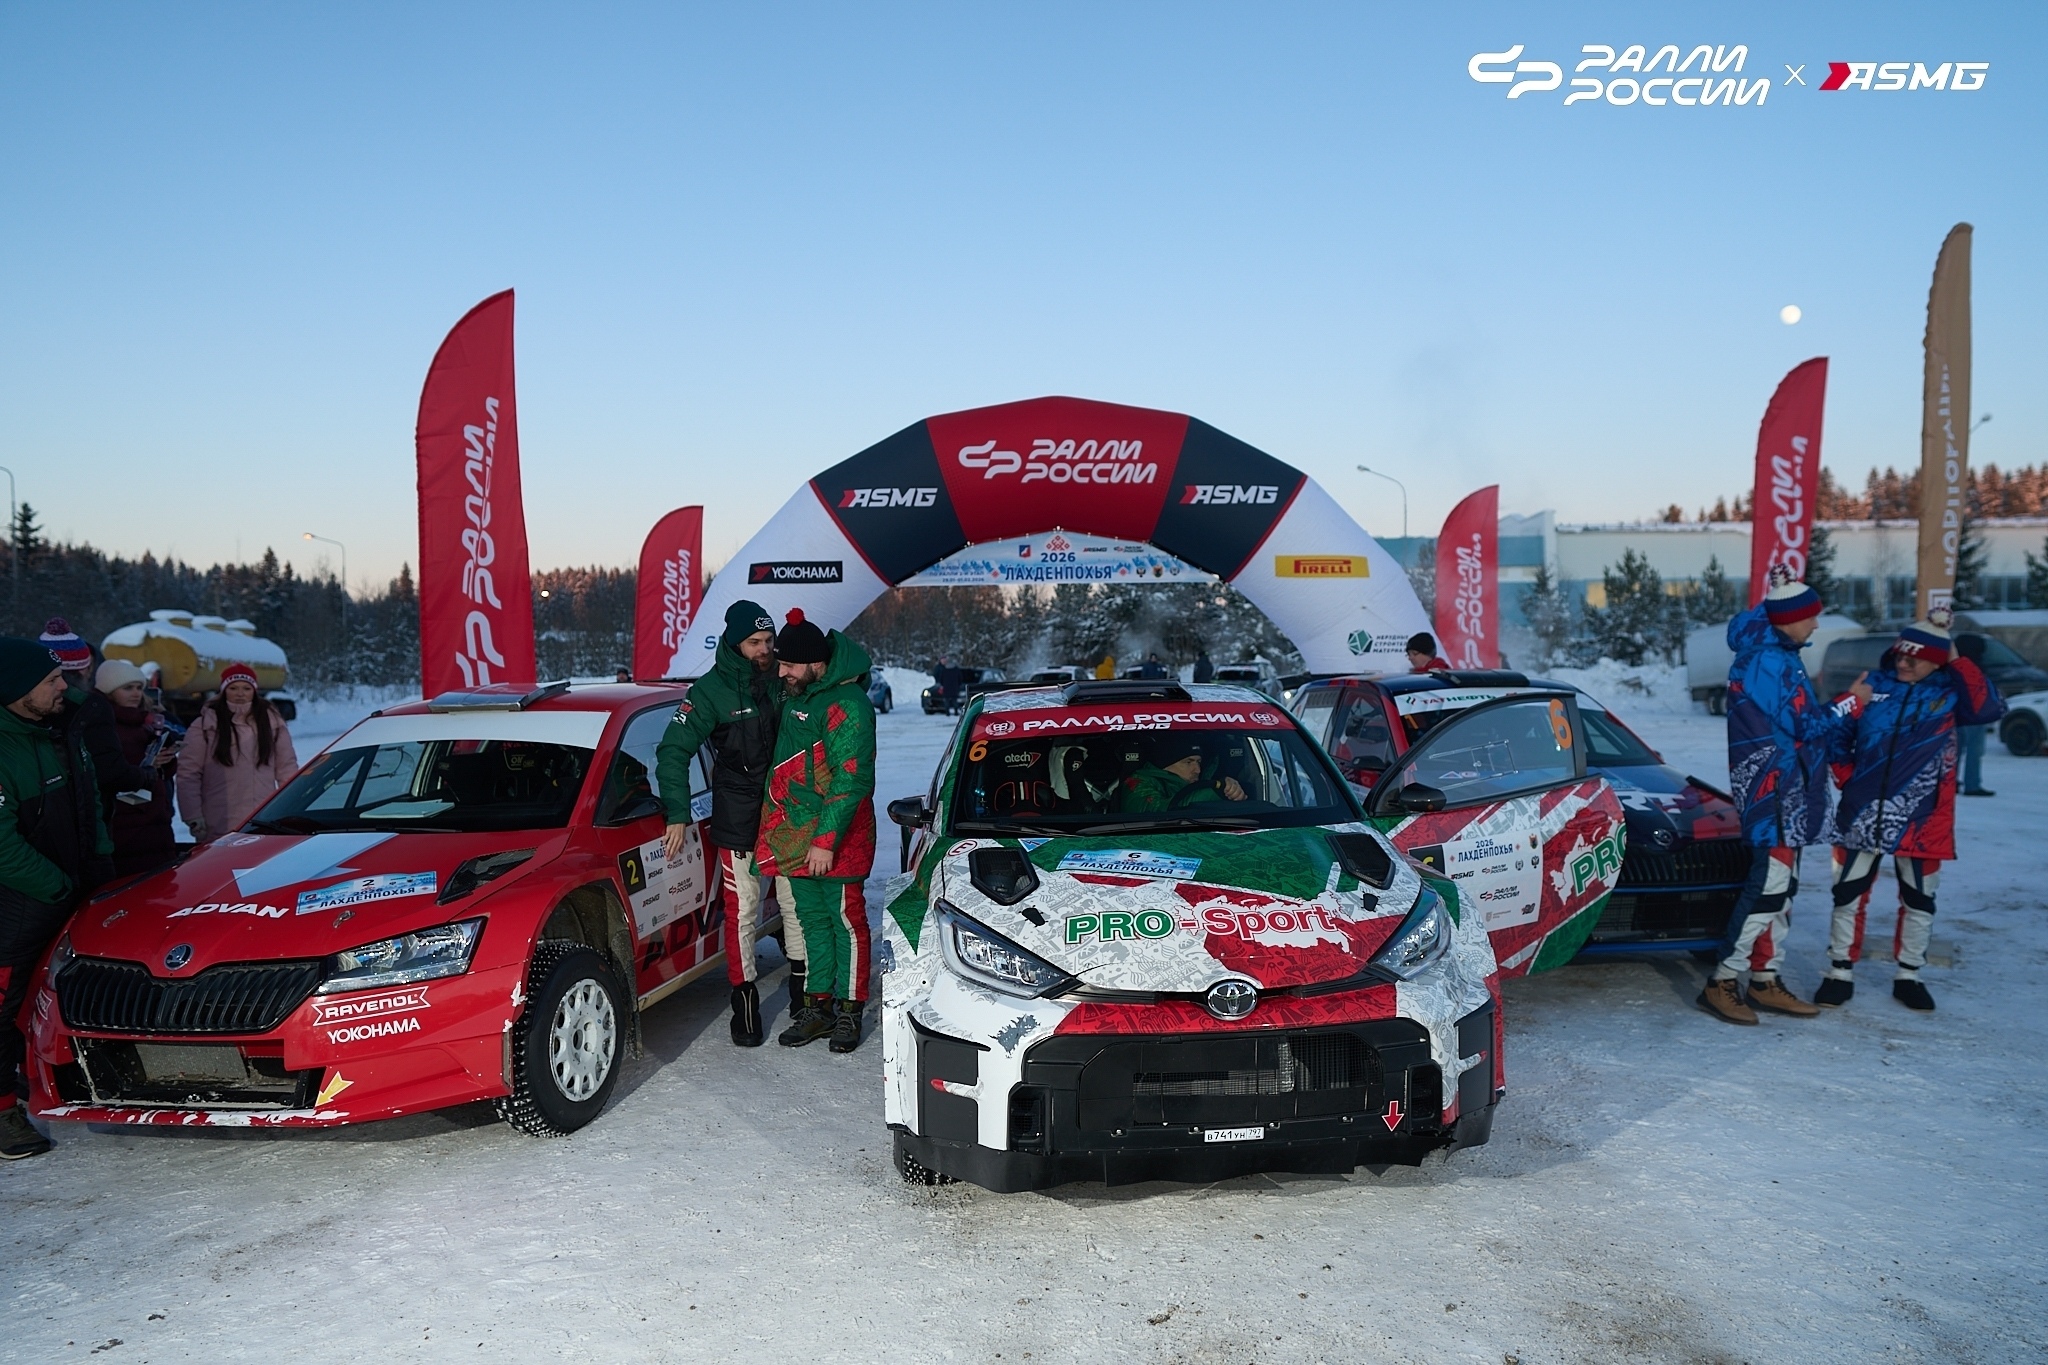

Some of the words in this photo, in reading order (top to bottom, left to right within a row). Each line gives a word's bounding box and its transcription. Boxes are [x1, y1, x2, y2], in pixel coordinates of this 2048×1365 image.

[1028, 439, 1143, 460] РАЛЛИ
[1020, 463, 1158, 484] РОССИИ
[848, 487, 938, 508] ASMG
[1190, 484, 1279, 505] ASMG
[1040, 552, 1076, 563] 2026
[1294, 559, 1352, 574] PIRELLI
[771, 566, 839, 579] YOKOHAMA
[1005, 565, 1112, 582] ЛАХДЕНПОХЬЯ
[662, 559, 678, 650] РАЛЛИ
[1023, 715, 1125, 731] РАЛЛИ
[1133, 713, 1246, 724] РОССИИ
[1549, 698, 1573, 749] 6
[969, 739, 989, 761] 6
[1004, 751, 1031, 763] atech
[1125, 753, 1140, 761] OMP
[1475, 838, 1494, 849] 2026
[1458, 844, 1514, 863] ЛАХДЕНПОХЬЯ
[626, 859, 640, 886] 2
[1079, 862, 1174, 875] ЛАХДЕНПОХЬЯ
[361, 879, 376, 887] 2
[319, 887, 416, 908] ЛАХДЕНПОХЬЯ
[165, 903, 290, 919] ADVAN
[325, 994, 419, 1019] RAVENOL
[327, 1017, 421, 1045] YOKOHAMA
